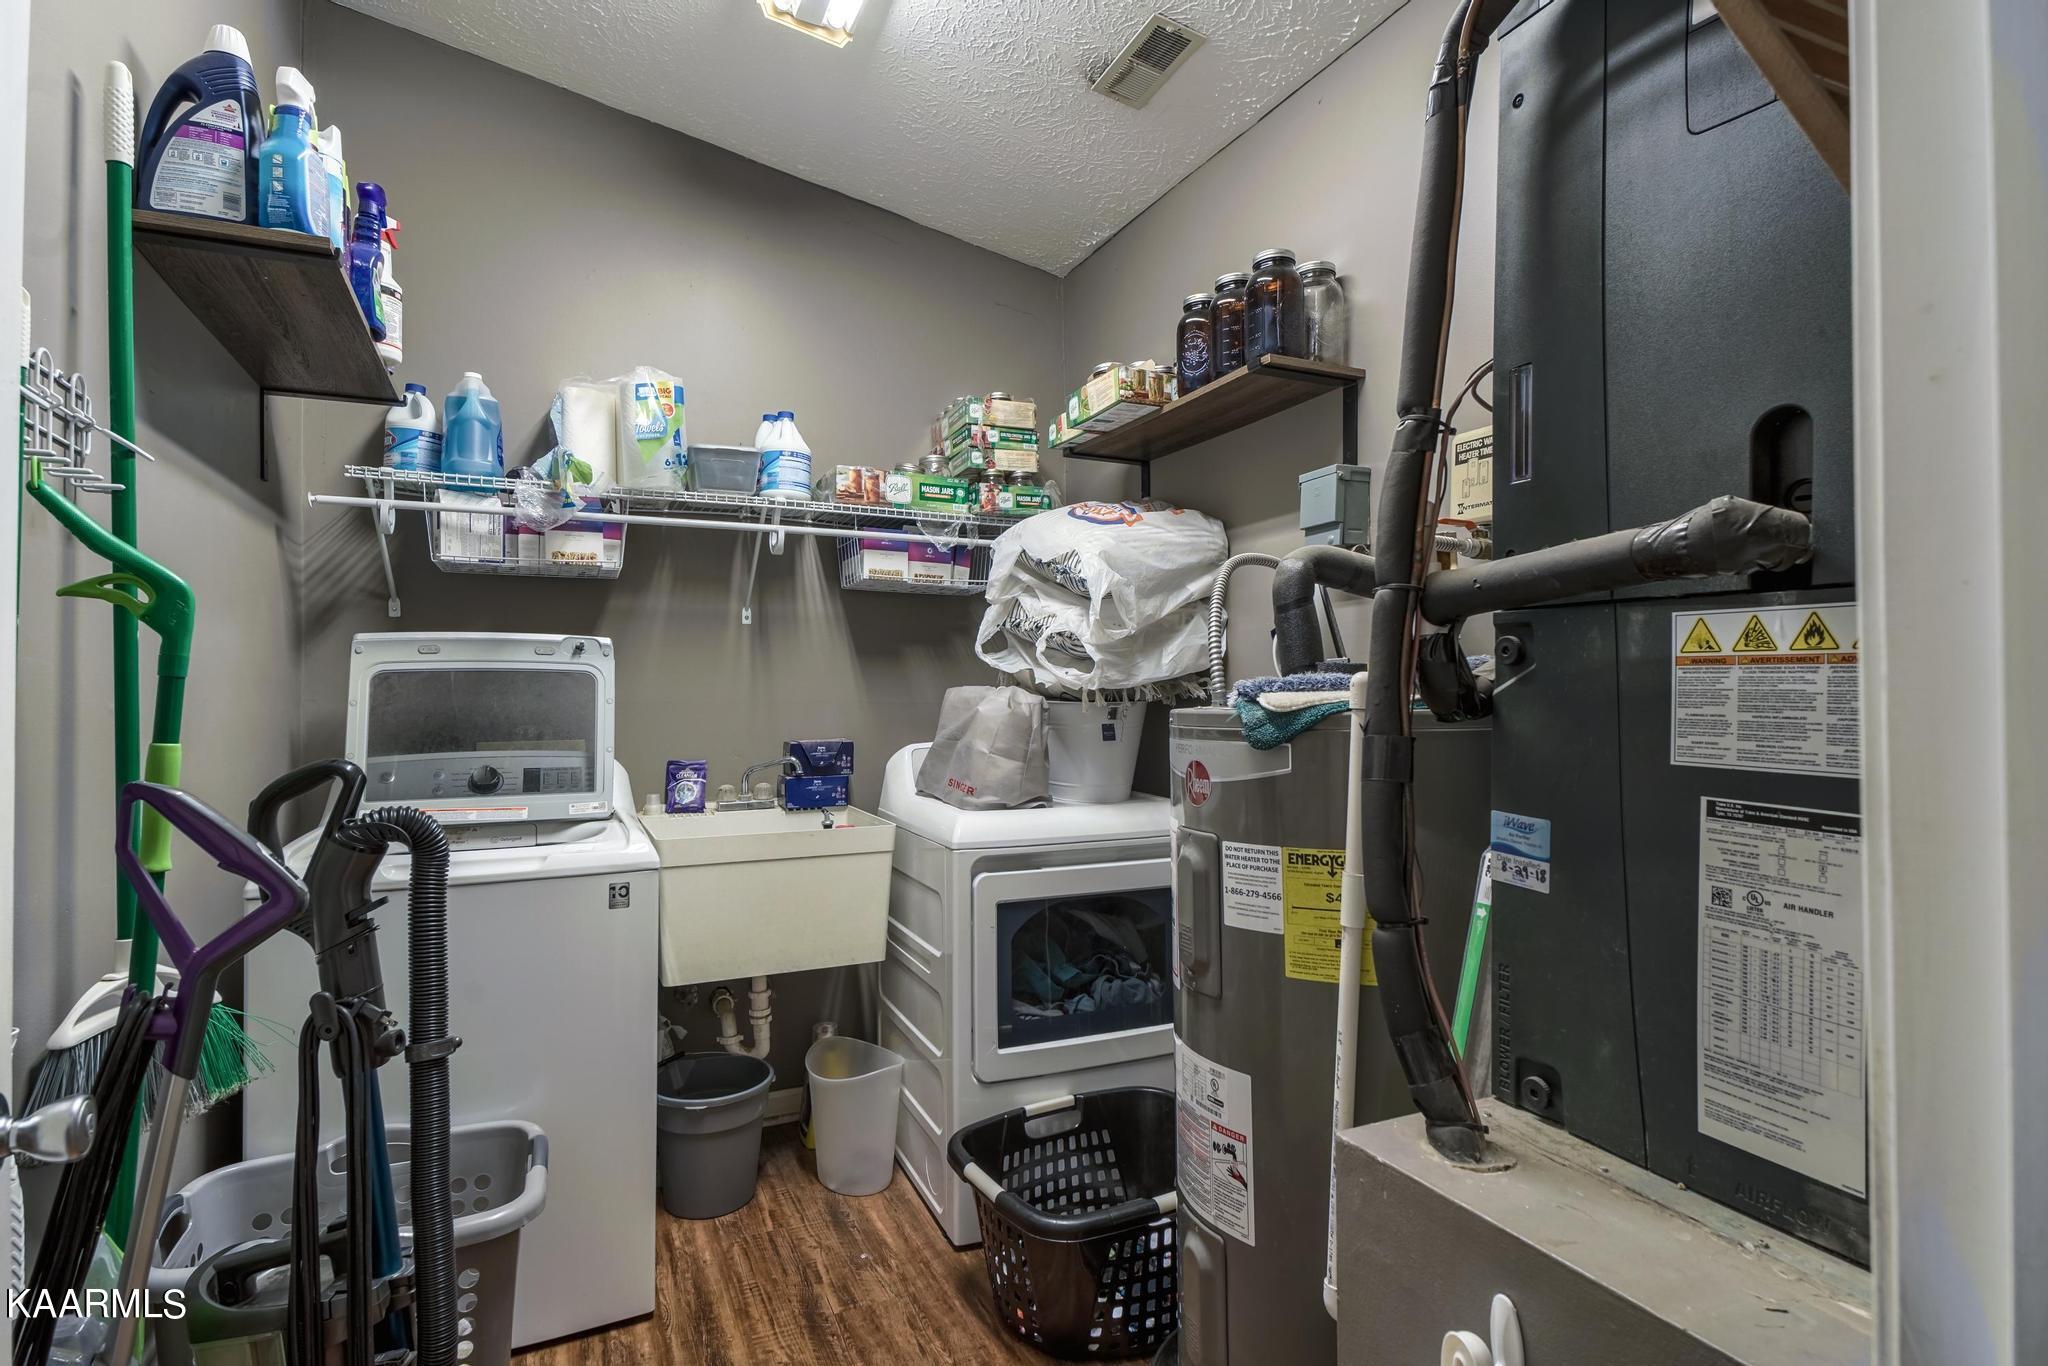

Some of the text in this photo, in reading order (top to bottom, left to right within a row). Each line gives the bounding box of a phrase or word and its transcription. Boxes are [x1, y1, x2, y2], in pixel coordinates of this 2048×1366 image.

[635, 420, 664, 433] Towels
[1457, 440, 1483, 453] ELECTRIC
[1458, 449, 1480, 461] HEATER
[921, 485, 954, 495] MASON JARS
[1691, 657, 1727, 665] WARNING
[1750, 655, 1820, 664] AVERTISSEMENT
[1187, 760, 1211, 799] Rheem
[948, 778, 975, 796] SINGER
[1504, 815, 1536, 832] iWave
[1241, 855, 1260, 863] HEATER
[1288, 852, 1346, 868] ENERGYG
[1226, 861, 1241, 869] PLACE
[1249, 864, 1279, 873] PURCHASE
[1501, 861, 1547, 884] 8-29-18
[1224, 886, 1282, 901] 1-866-279-4566
[1783, 902, 1834, 919] AIR HANDLER
[1218, 1126, 1245, 1142] DANGER
